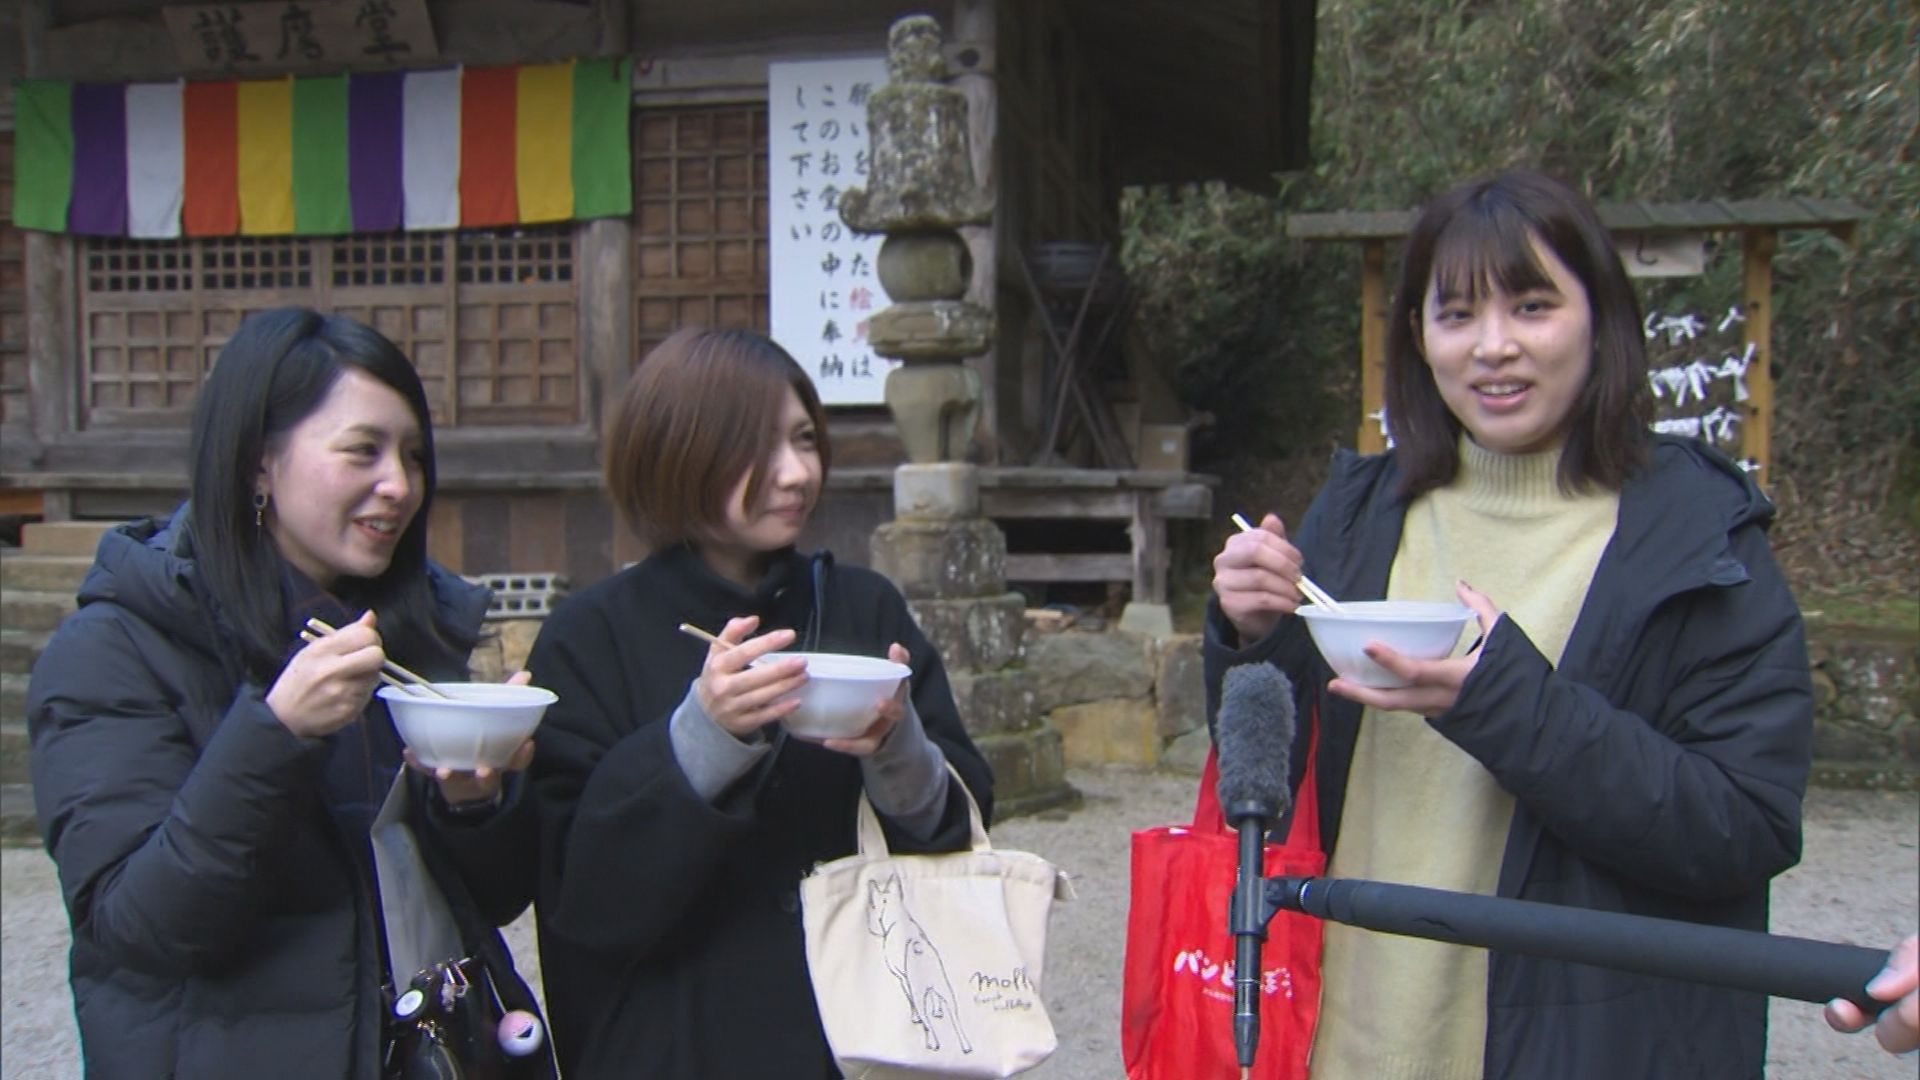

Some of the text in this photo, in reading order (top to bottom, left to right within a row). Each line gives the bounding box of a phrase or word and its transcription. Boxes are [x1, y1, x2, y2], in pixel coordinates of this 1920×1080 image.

[790, 86, 813, 241] して下さい
